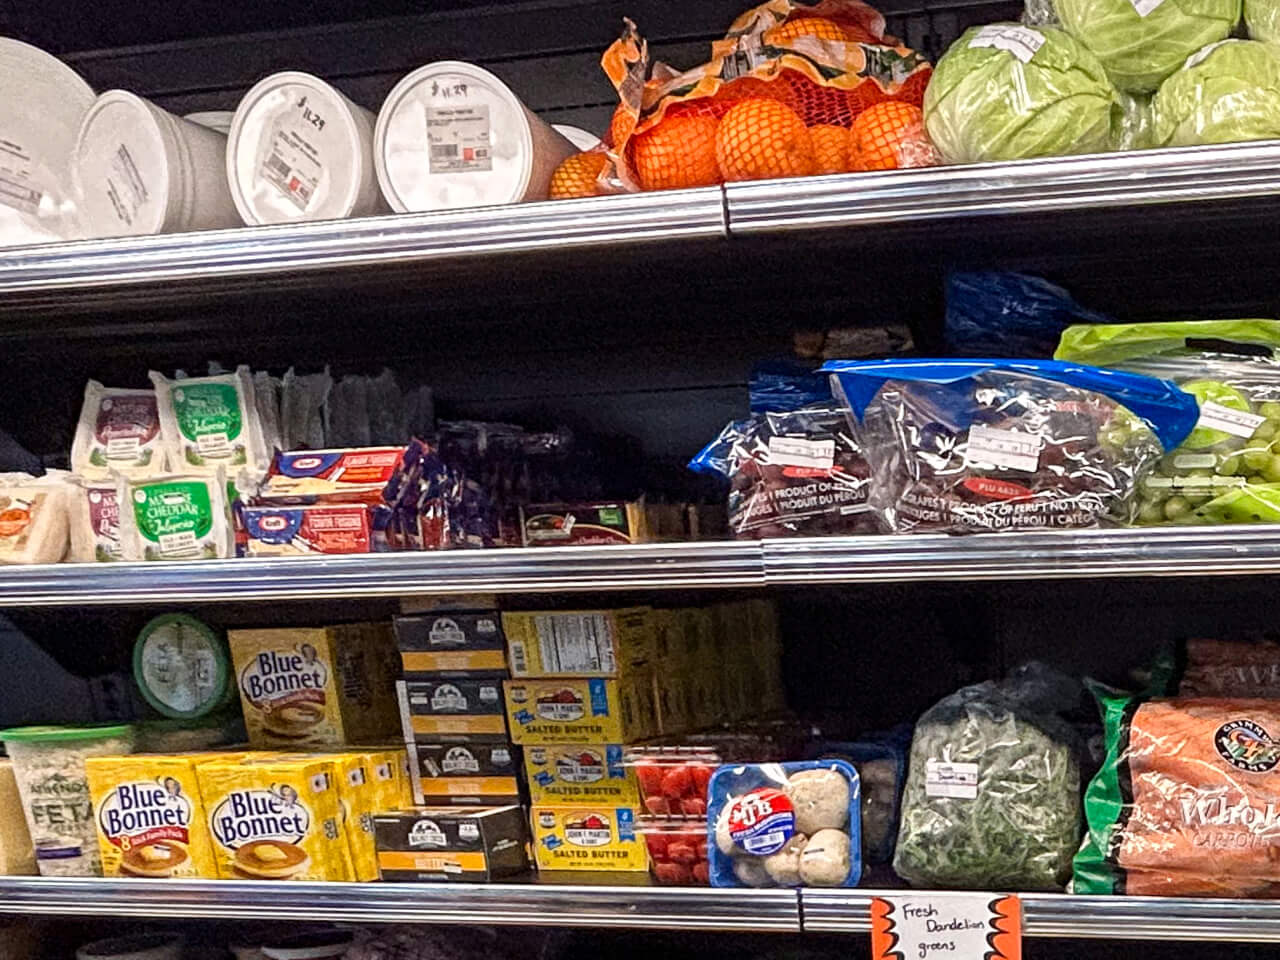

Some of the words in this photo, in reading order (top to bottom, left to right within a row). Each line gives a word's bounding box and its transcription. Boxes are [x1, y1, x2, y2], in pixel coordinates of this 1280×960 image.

[775, 486, 818, 499] PRODUCT
[779, 497, 818, 510] PRODUIT
[819, 494, 833, 504] DU
[259, 651, 303, 675] Blue
[250, 671, 323, 698] Bonnet
[525, 725, 561, 734] SALTED
[565, 725, 603, 734] BUTTER
[119, 786, 166, 811] Blue
[545, 787, 580, 796] SALTED
[584, 787, 621, 796] BUTTER
[232, 792, 280, 818] Blue
[109, 807, 187, 836] Bonnet
[222, 813, 302, 844] Bonnet
[553, 850, 588, 859] SALTED
[592, 850, 629, 859] BUTTER
[902, 903, 939, 920] Fresh
[926, 918, 985, 933] Dandelion
[918, 940, 956, 958] greens
